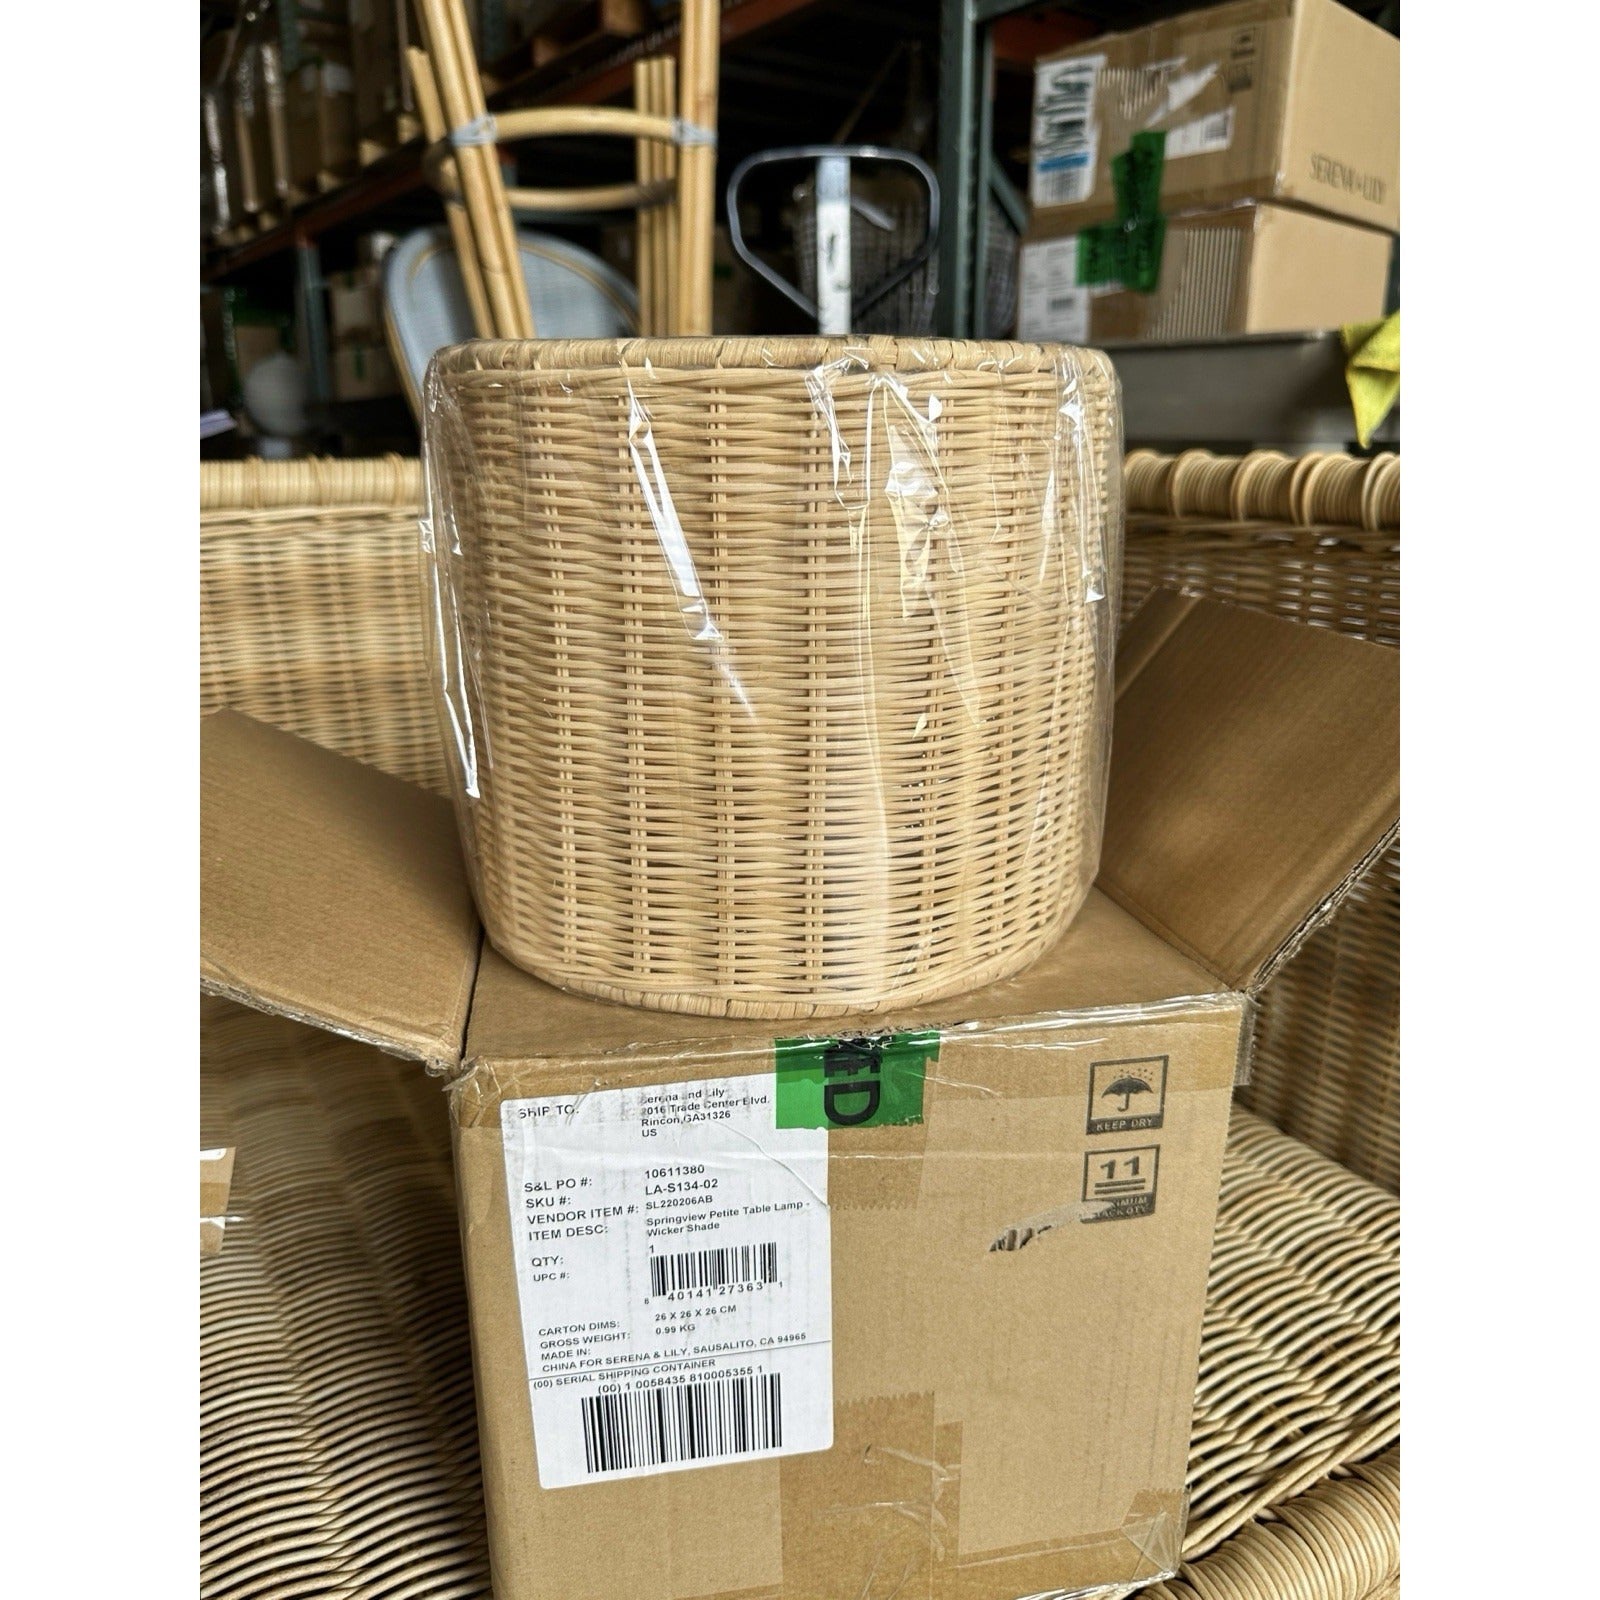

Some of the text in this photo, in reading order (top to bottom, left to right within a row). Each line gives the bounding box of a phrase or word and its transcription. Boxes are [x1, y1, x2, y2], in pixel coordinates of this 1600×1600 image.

[670, 1102, 701, 1112] Trade
[704, 1098, 740, 1109] Center
[641, 1110, 731, 1127] Rincon,GA31326
[1096, 1117, 1153, 1132] KEEP DRY
[642, 1129, 657, 1138] US
[645, 1164, 705, 1180] 10611380
[1100, 1155, 1139, 1179] 11
[525, 1177, 592, 1192] S&L PO #:
[645, 1178, 718, 1196] LA-S134-02
[526, 1196, 571, 1209] SKU #:
[645, 1195, 713, 1210] SL220206AB
[527, 1205, 639, 1225] VENDOR ITEM #:
[646, 1211, 706, 1227] Springview
[709, 1208, 739, 1219] Petite
[743, 1204, 771, 1214] Table
[774, 1200, 803, 1213] Lamp
[529, 1225, 608, 1241] ITEM DESC:
[647, 1221, 720, 1237] Wicker Shade
[650, 1244, 655, 1254] 1
[531, 1255, 564, 1267] QTY:
[533, 1271, 570, 1282] UPC #:
[667, 1288, 712, 1301] 40141
[719, 1281, 764, 1295] 27363
[655, 1304, 737, 1321] 26 X 26 X 26 CM
[538, 1320, 620, 1336] CARTON DIMS:
[656, 1323, 696, 1335] 0.99 KG
[540, 1331, 630, 1349] GROSS WEIGHT:
[541, 1348, 591, 1361] MADE IN:
[542, 1332, 806, 1372] CHINA FOR SERENA & LILY, SAUSALITO, CA 94965
[533, 1358, 716, 1390] (00) SERIAL SHIPPING CONTAINER
[598, 1383, 621, 1394] (00)
[635, 1375, 686, 1389] 0058435
[689, 1366, 754, 1382] 810005355
